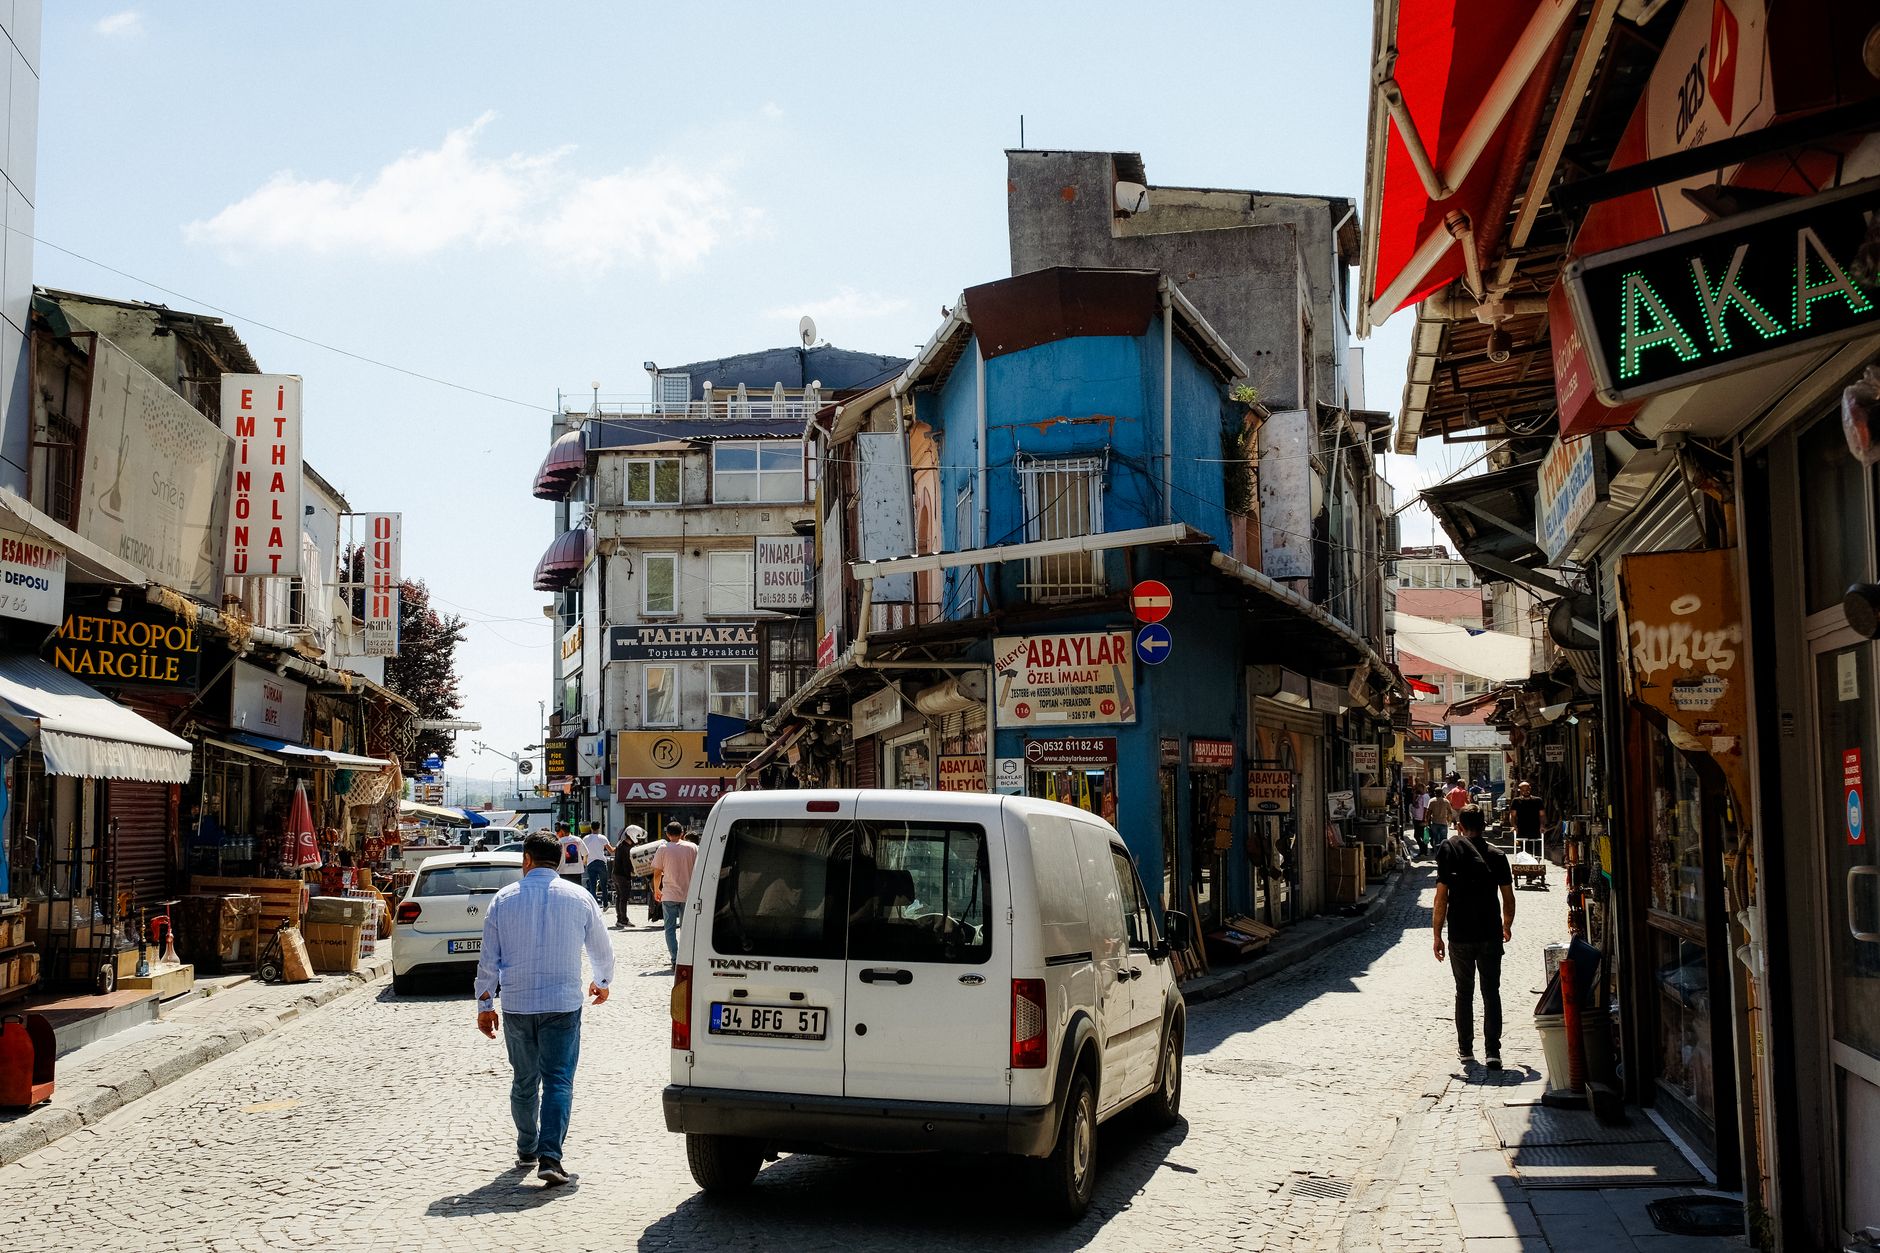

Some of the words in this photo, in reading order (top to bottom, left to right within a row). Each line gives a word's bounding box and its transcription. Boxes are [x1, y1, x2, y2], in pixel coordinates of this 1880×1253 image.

[1620, 210, 1880, 378] AKA
[234, 389, 256, 574] EMİNÖNÜ
[268, 385, 287, 574] İTHALAT
[5, 571, 49, 591] DEPOSU
[764, 569, 806, 586] BASKÜL
[56, 614, 200, 653] METROPOL
[648, 648, 687, 658] Toptan
[995, 641, 1029, 671] BİLEYCİ
[1026, 636, 1127, 668] ABAYLAR
[55, 646, 180, 681] NARGİLE
[1028, 669, 1055, 685] ÖZEL
[1058, 668, 1099, 683] İMALAT
[1043, 742, 1063, 751] 0532
[1066, 742, 1079, 750] 611
[1081, 741, 1091, 750] 82
[1093, 741, 1103, 750] 45
[939, 759, 986, 774] ABAYLAR
[1044, 755, 1108, 763] www.abaylarkeser.com
[1249, 772, 1289, 784] ABAYLAR
[626, 782, 667, 799] AS
[454, 942, 463, 950] 34
[708, 958, 771, 971] TRANSIT
[774, 964, 819, 973] connect
[722, 1008, 742, 1027] 34
[752, 1009, 783, 1030] BFG
[799, 1011, 819, 1032] 51
